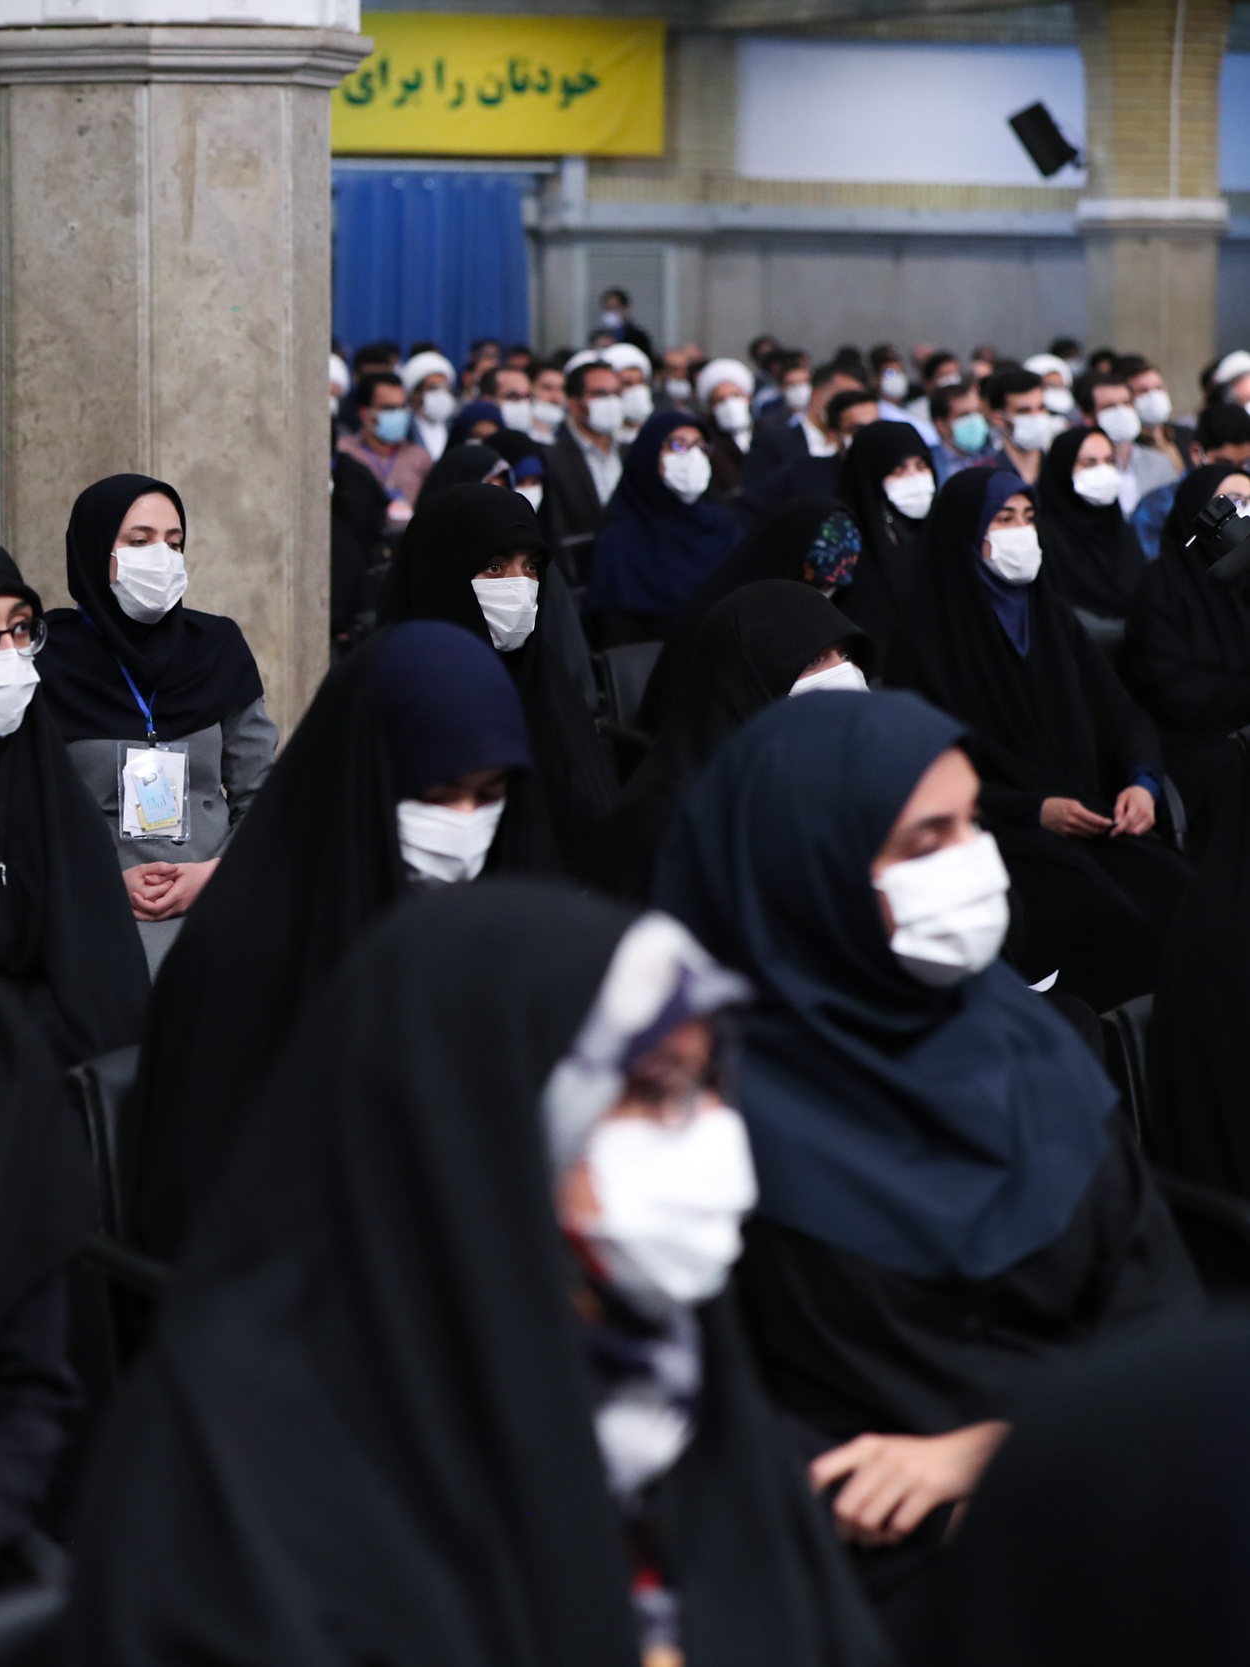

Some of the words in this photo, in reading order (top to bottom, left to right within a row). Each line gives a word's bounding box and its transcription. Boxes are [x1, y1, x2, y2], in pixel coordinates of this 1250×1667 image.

[341, 57, 424, 108] برای
[433, 57, 466, 109] را
[474, 56, 600, 110] خودتان
